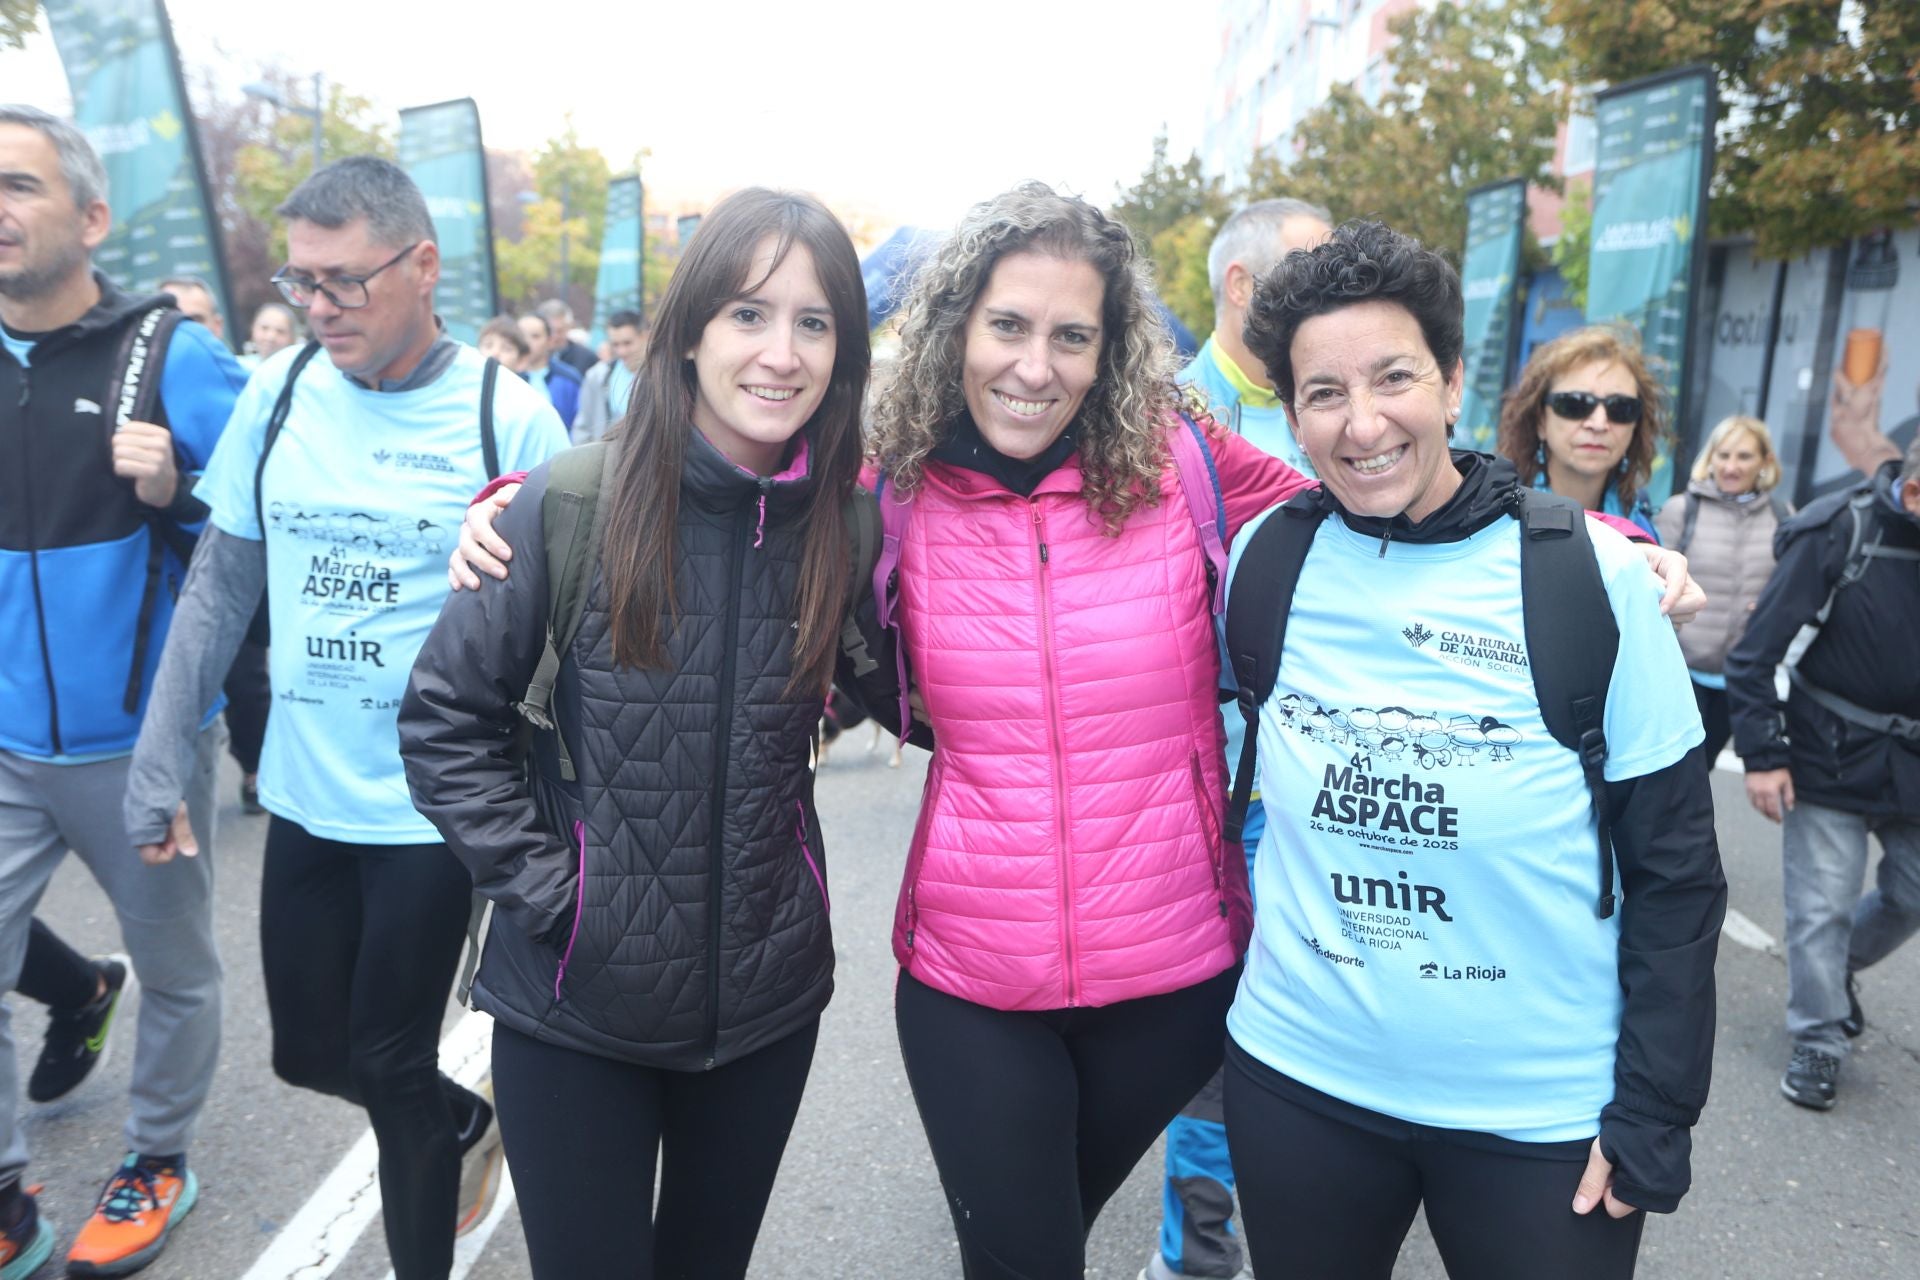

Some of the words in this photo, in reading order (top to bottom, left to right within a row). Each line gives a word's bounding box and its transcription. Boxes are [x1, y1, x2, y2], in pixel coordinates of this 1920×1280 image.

[329, 545, 347, 560] 41
[311, 555, 391, 581] Marcha
[302, 574, 400, 604] ASPACE
[1439, 641, 1459, 654] DE
[1463, 645, 1529, 667] NAVARRA
[1441, 631, 1476, 646] CAJA
[1478, 636, 1524, 654] RURAL
[1438, 653, 1481, 668] ACCIÓN
[1486, 661, 1528, 676] SOCIAL
[376, 699, 390, 710] La
[1350, 752, 1373, 773] 41
[1323, 763, 1445, 804] Marcha
[1311, 789, 1459, 838] ASPACE
[1310, 820, 1325, 832] 26
[1327, 824, 1344, 835] de
[1347, 827, 1397, 846] octubre
[1399, 836, 1419, 847] de
[1422, 838, 1459, 851] 2025
[1336, 905, 1411, 927] UNIVERSIDAD
[1340, 918, 1429, 941] INTERNACIONAL
[1341, 928, 1354, 940] DE
[1354, 933, 1367, 946] LA
[1368, 938, 1402, 951] RIOJA
[1443, 966, 1462, 980] La
[1466, 966, 1507, 982] Rioja
